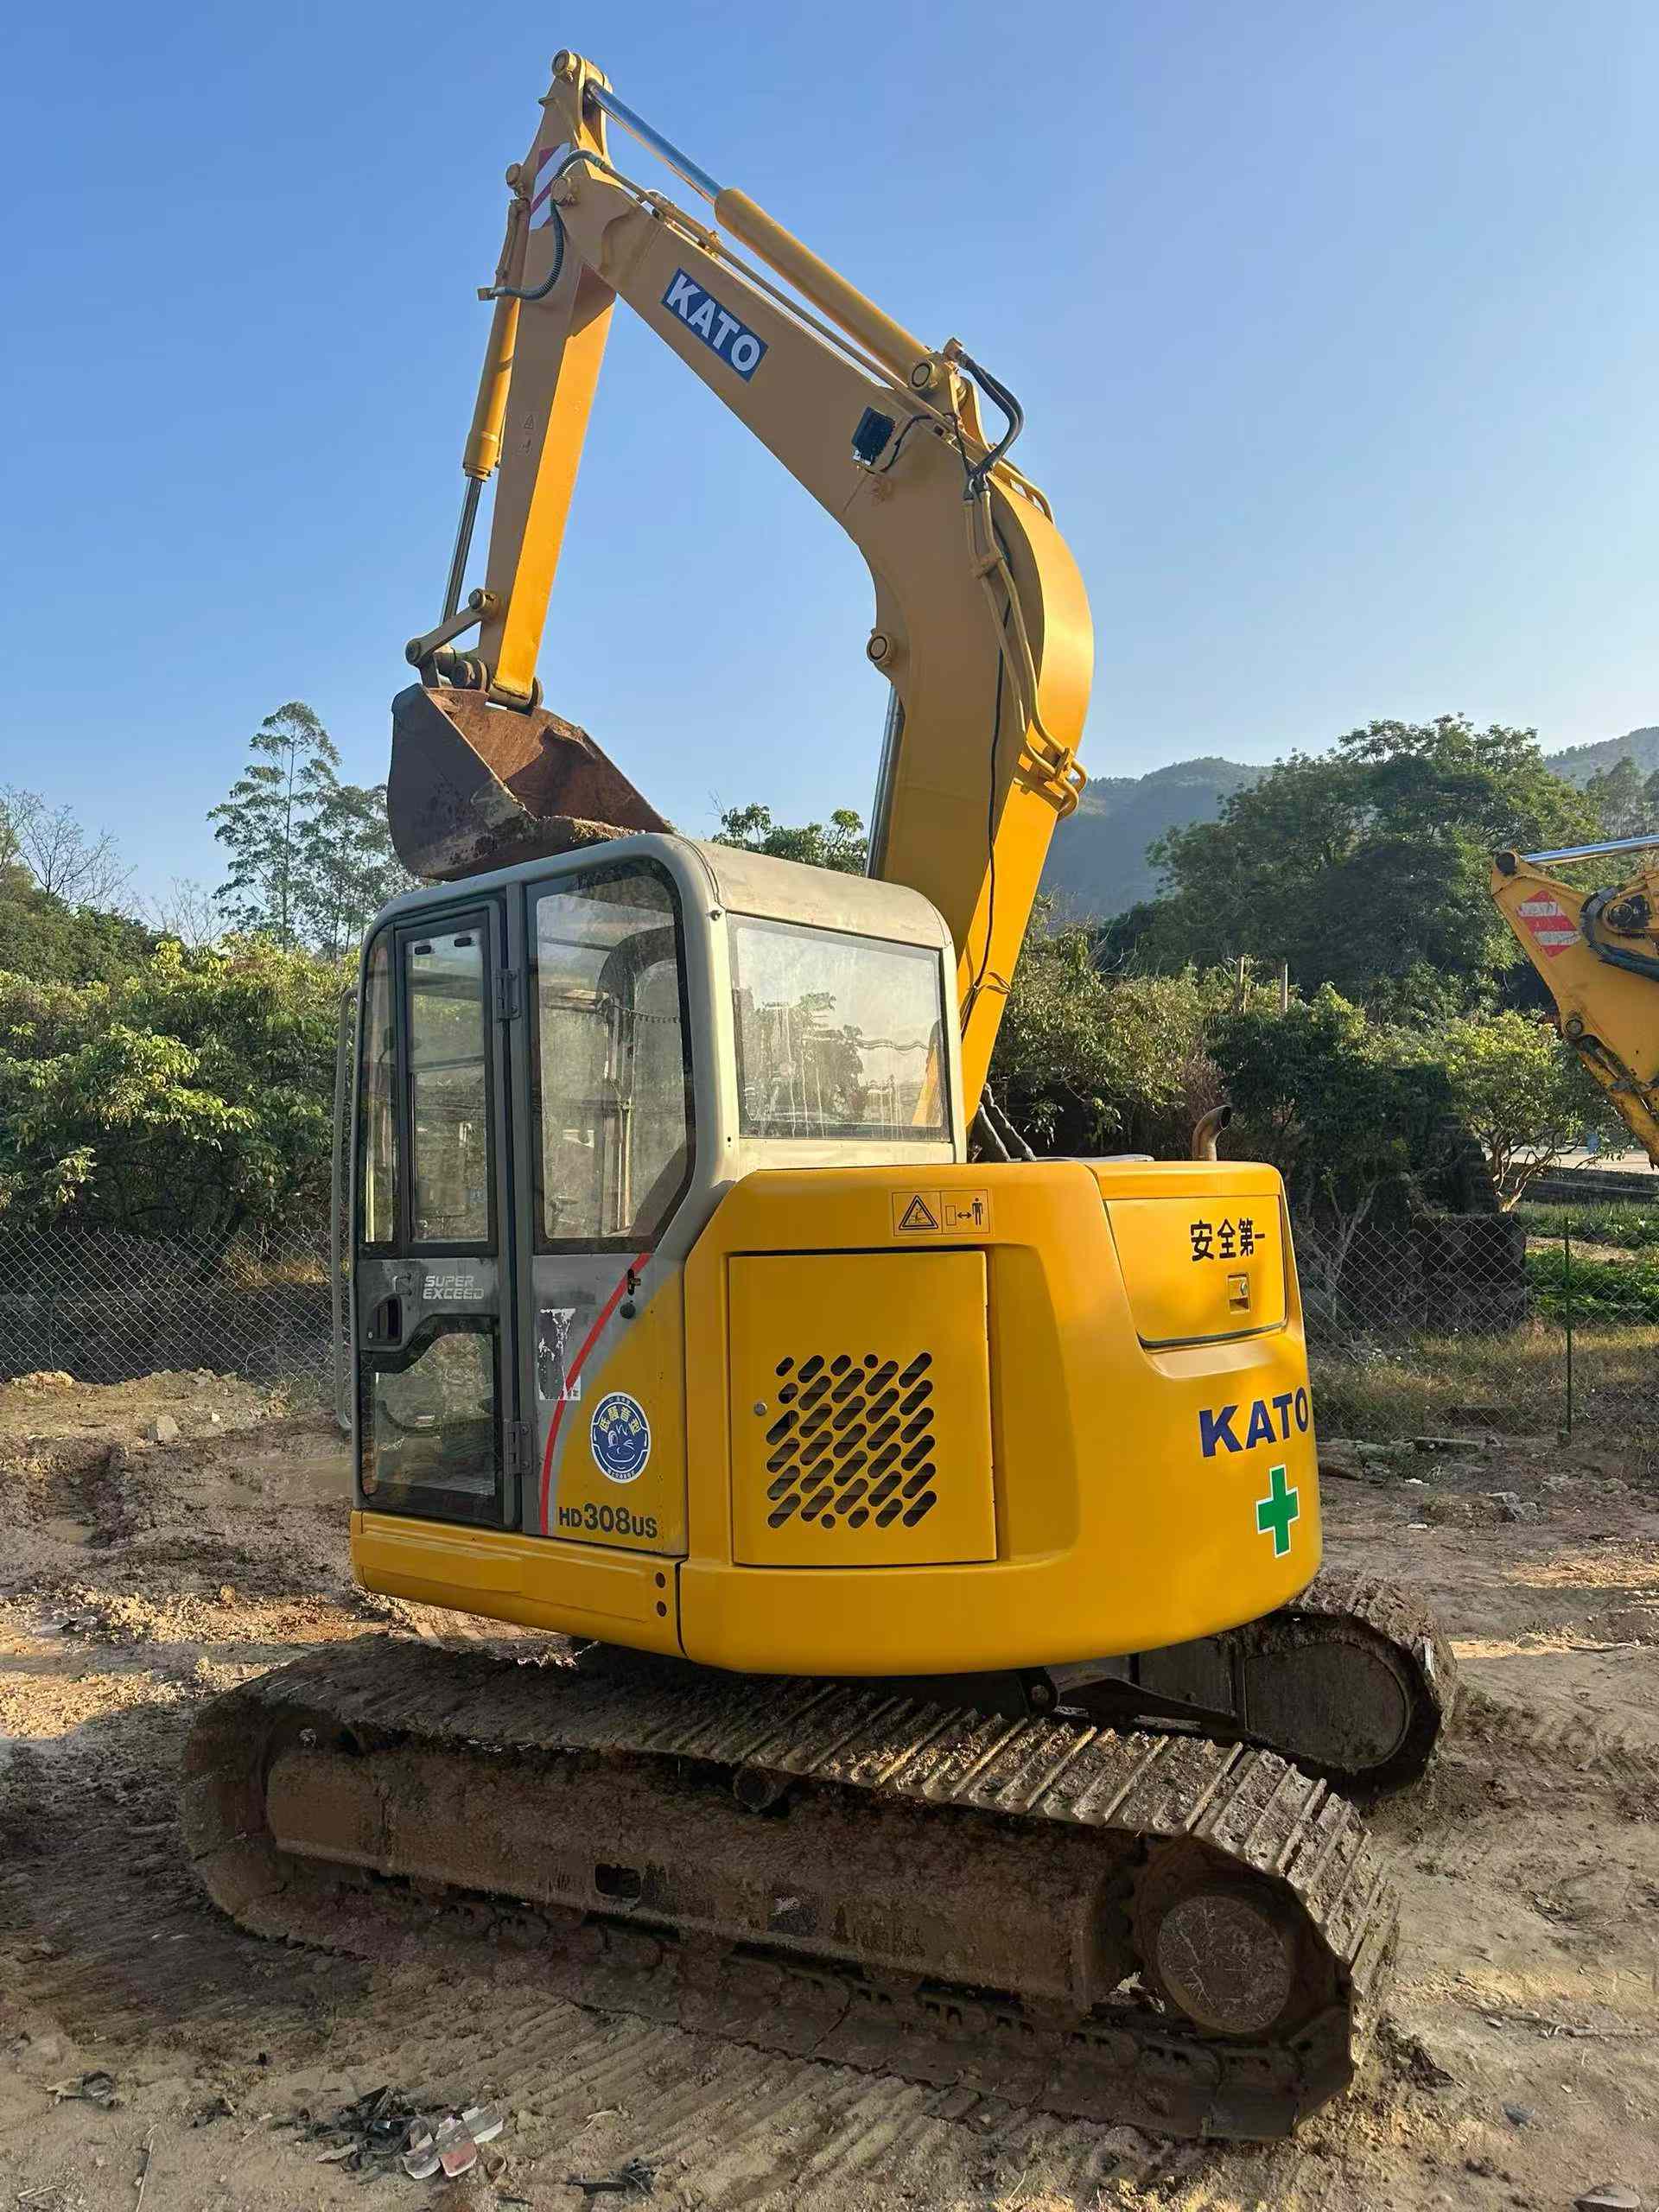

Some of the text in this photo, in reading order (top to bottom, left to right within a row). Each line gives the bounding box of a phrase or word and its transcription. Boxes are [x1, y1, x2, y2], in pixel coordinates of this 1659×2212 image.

[666, 273, 760, 372] KATO
[1191, 1217, 1266, 1262] 安全第一
[423, 1275, 474, 1287] SUPER
[423, 1287, 485, 1300] EXCEED
[1199, 1386, 1309, 1458] KATO
